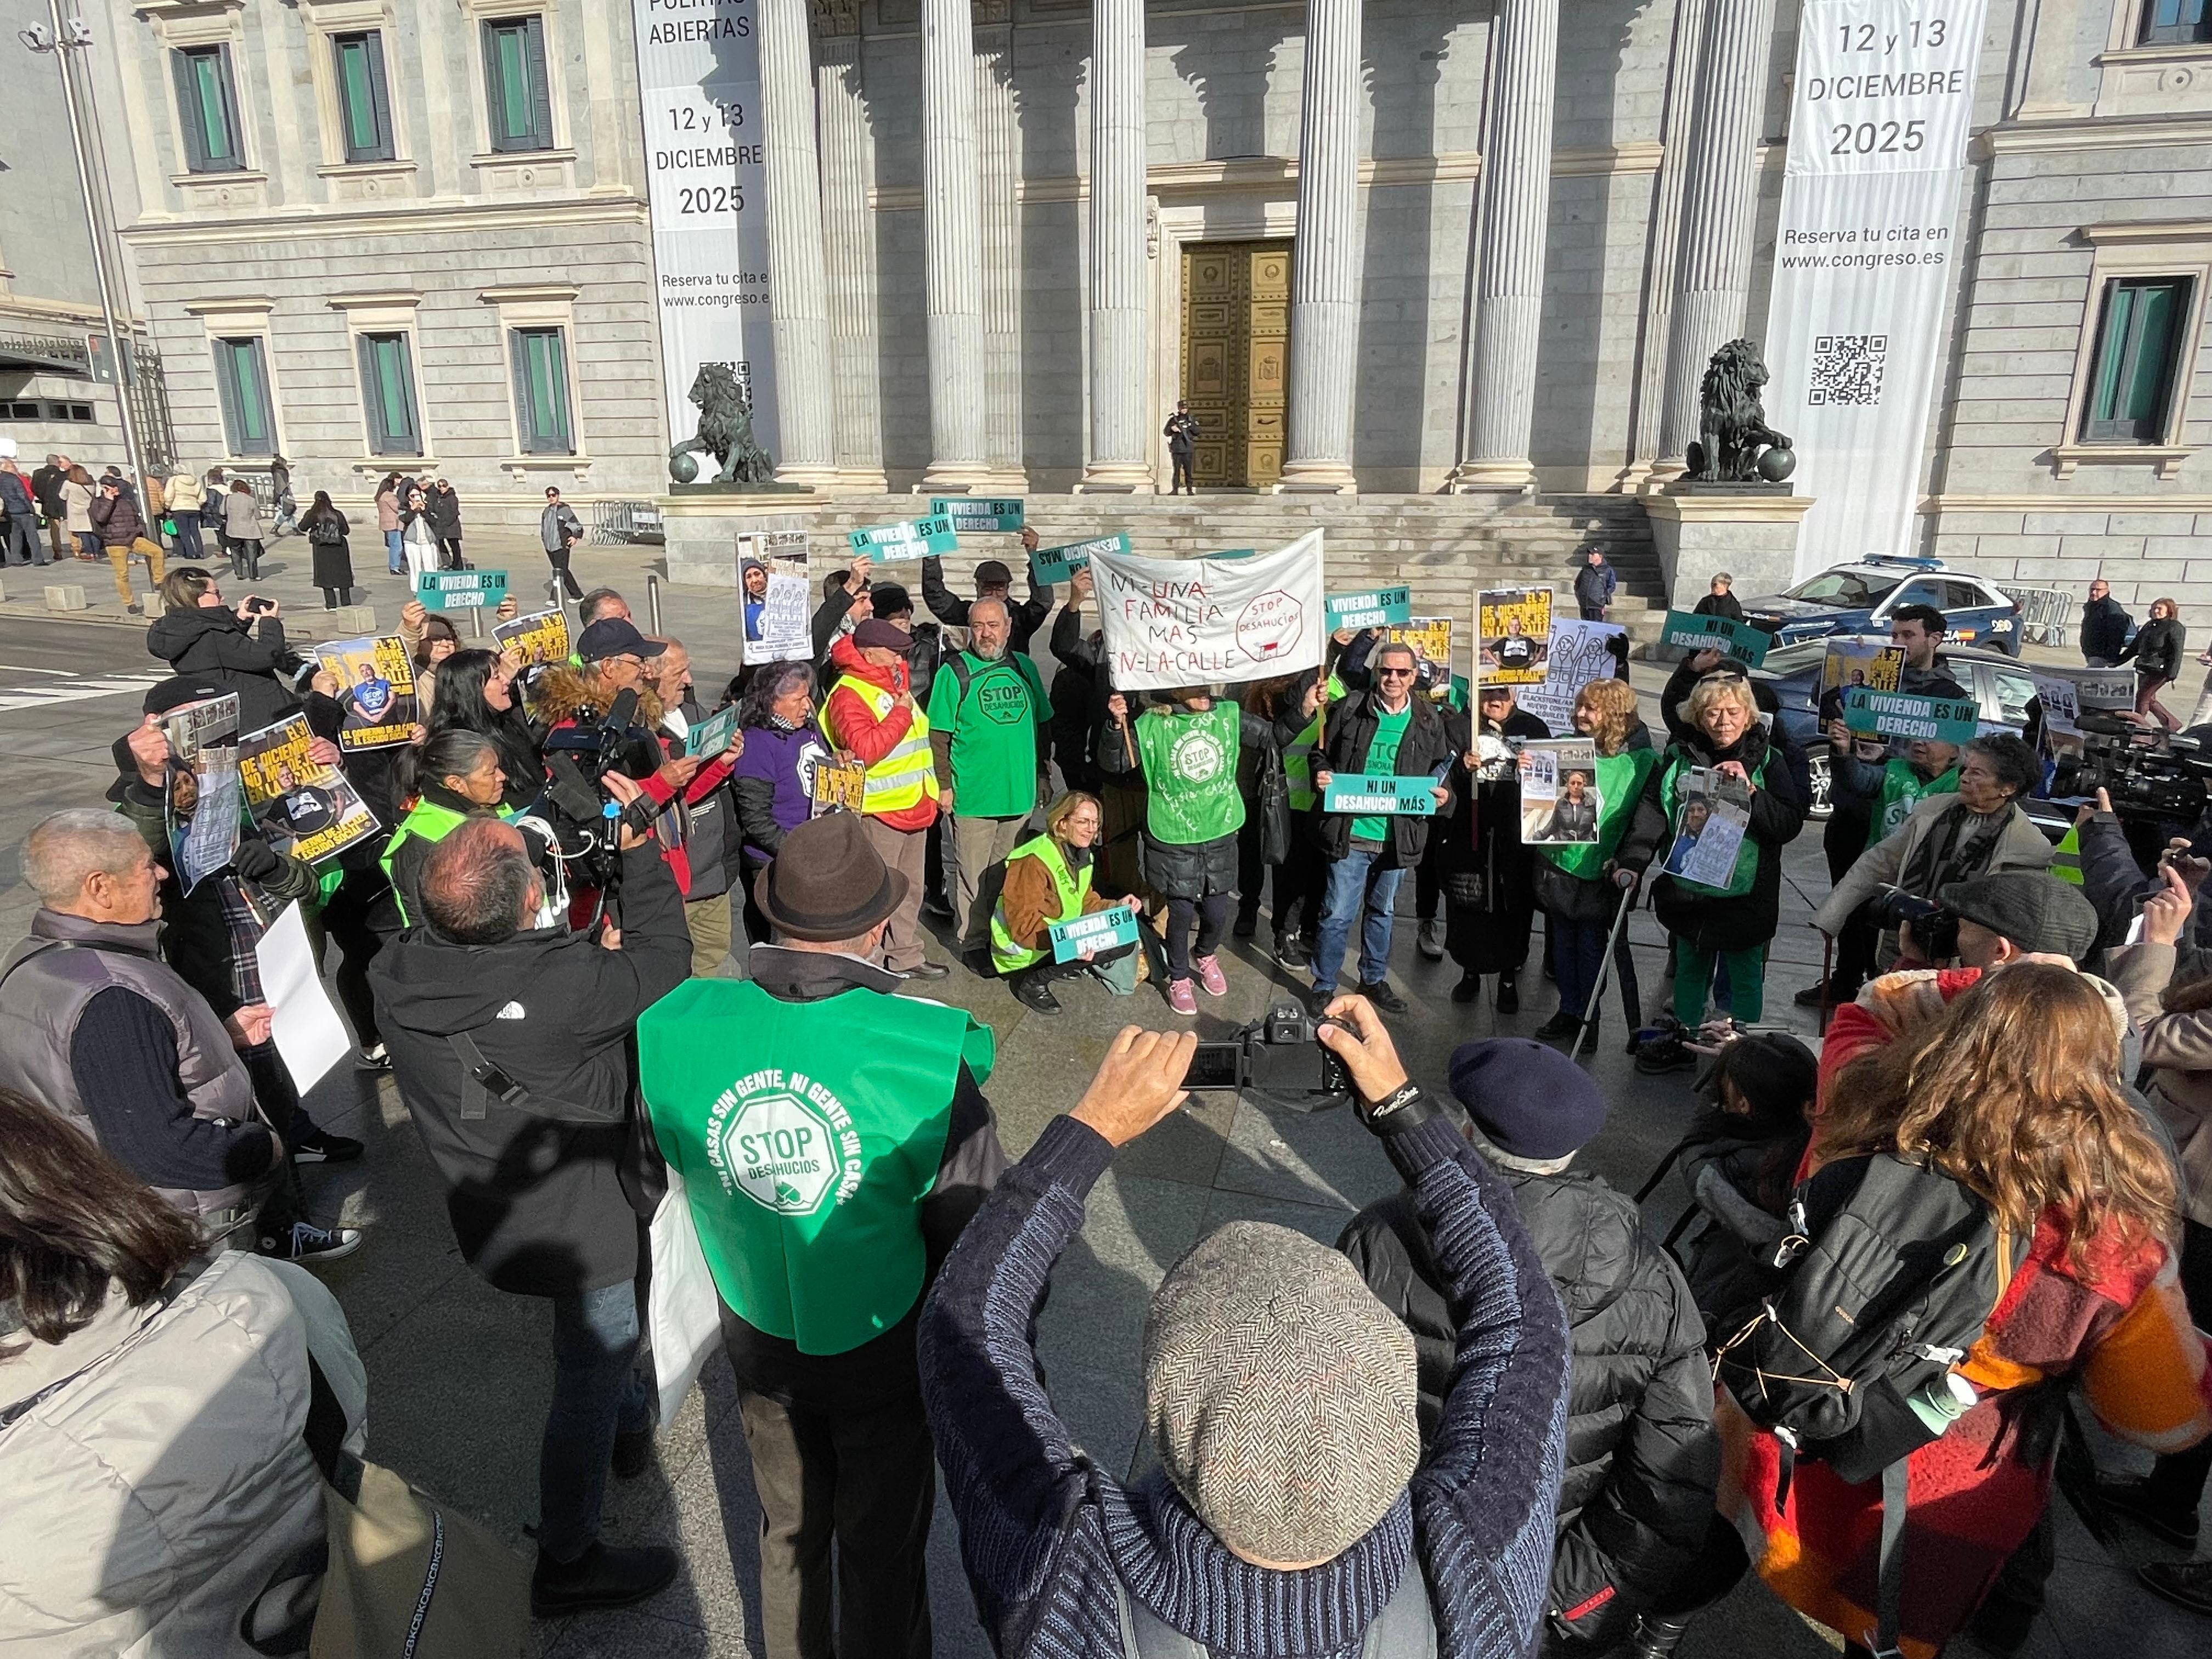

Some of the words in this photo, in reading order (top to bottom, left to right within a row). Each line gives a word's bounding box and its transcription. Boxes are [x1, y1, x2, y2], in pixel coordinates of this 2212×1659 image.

[650, 16, 749, 44] ABIERTAS
[1839, 24, 1875, 53] 12
[1884, 33, 1898, 55] y
[1909, 20, 1946, 48] 13
[1808, 70, 1964, 100] DICIEMBRE
[669, 108, 696, 131] 12
[702, 115, 710, 132] y
[718, 104, 744, 127] 13
[1831, 120, 1925, 155] 2025
[656, 145, 763, 170] DICIEMBRE
[680, 185, 744, 214] 2025
[1785, 229, 1856, 245] Reserva
[1863, 227, 1880, 242] tu
[1887, 224, 1920, 241] cita
[1927, 226, 1949, 240] en
[1782, 252, 1944, 270] www.congreso.es
[662, 274, 712, 287] Reserva
[716, 273, 729, 285] tu
[733, 270, 757, 284] cita
[760, 274, 768, 284] e
[663, 293, 768, 308] www.congreso.e
[934, 503, 944, 515] LA
[947, 503, 991, 515] VIVIENDA
[994, 503, 1005, 515] ES
[1008, 503, 1020, 515] UN
[854, 533, 869, 548] LA
[869, 524, 917, 544] VIVIENA
[919, 523, 933, 537] ES
[934, 519, 949, 533] UN
[956, 518, 998, 531] DERECHO
[423, 577, 436, 590] LA
[439, 575, 478, 590] VIVIENDA
[482, 575, 492, 589] ES
[495, 575, 505, 588] UN
[445, 591, 485, 608] DERECHO
[1251, 597, 1283, 615] STOP
[1331, 594, 1378, 613] VIVIENDA
[1381, 593, 1391, 606] ES
[1394, 590, 1406, 604] UN
[1526, 592, 1537, 603] EL
[1539, 591, 1550, 603] 31
[1341, 610, 1386, 629] DERECHO
[1482, 606, 1494, 616] DE
[1498, 603, 1549, 616] DICIEMBRE
[1149, 625, 1197, 644] MAS
[1706, 620, 1718, 633] NI
[1721, 622, 1735, 637] UN
[1671, 631, 1732, 653] DESAHUCIO
[1731, 644, 1754, 664] MÁS
[982, 686, 1021, 702] STOP
[1851, 693, 1865, 709] LA
[1870, 695, 1931, 718] VIVIENDA
[1933, 703, 1950, 719] ES
[1954, 706, 1974, 723] UN
[286, 725, 301, 741] EL
[296, 720, 310, 736] 31
[1876, 715, 1939, 738] DERECHO
[240, 757, 257, 775] DE
[1184, 748, 1209, 765] STOP
[244, 771, 262, 788] NO
[1367, 780, 1378, 793] NI
[1381, 780, 1396, 794] UN
[1334, 794, 1397, 811] DESAHUCIO
[1399, 795, 1425, 811] MÁS
[1054, 927, 1066, 943] LA
[1066, 915, 1108, 940] VIVIENDA
[1109, 912, 1121, 927] ES
[1121, 910, 1133, 924] UN
[1075, 930, 1118, 955] DERECHO
[735, 1069, 786, 1098] GENTE,
[789, 1071, 810, 1094] NI
[712, 1088, 738, 1120] SIN
[808, 1082, 853, 1132] GENTE
[1373, 1086, 1419, 1117] PowerShot
[707, 1117, 725, 1168] CASAS
[740, 1127, 812, 1165] STOP
[839, 1130, 862, 1157] SIN
[835, 1159, 862, 1200] CASA
